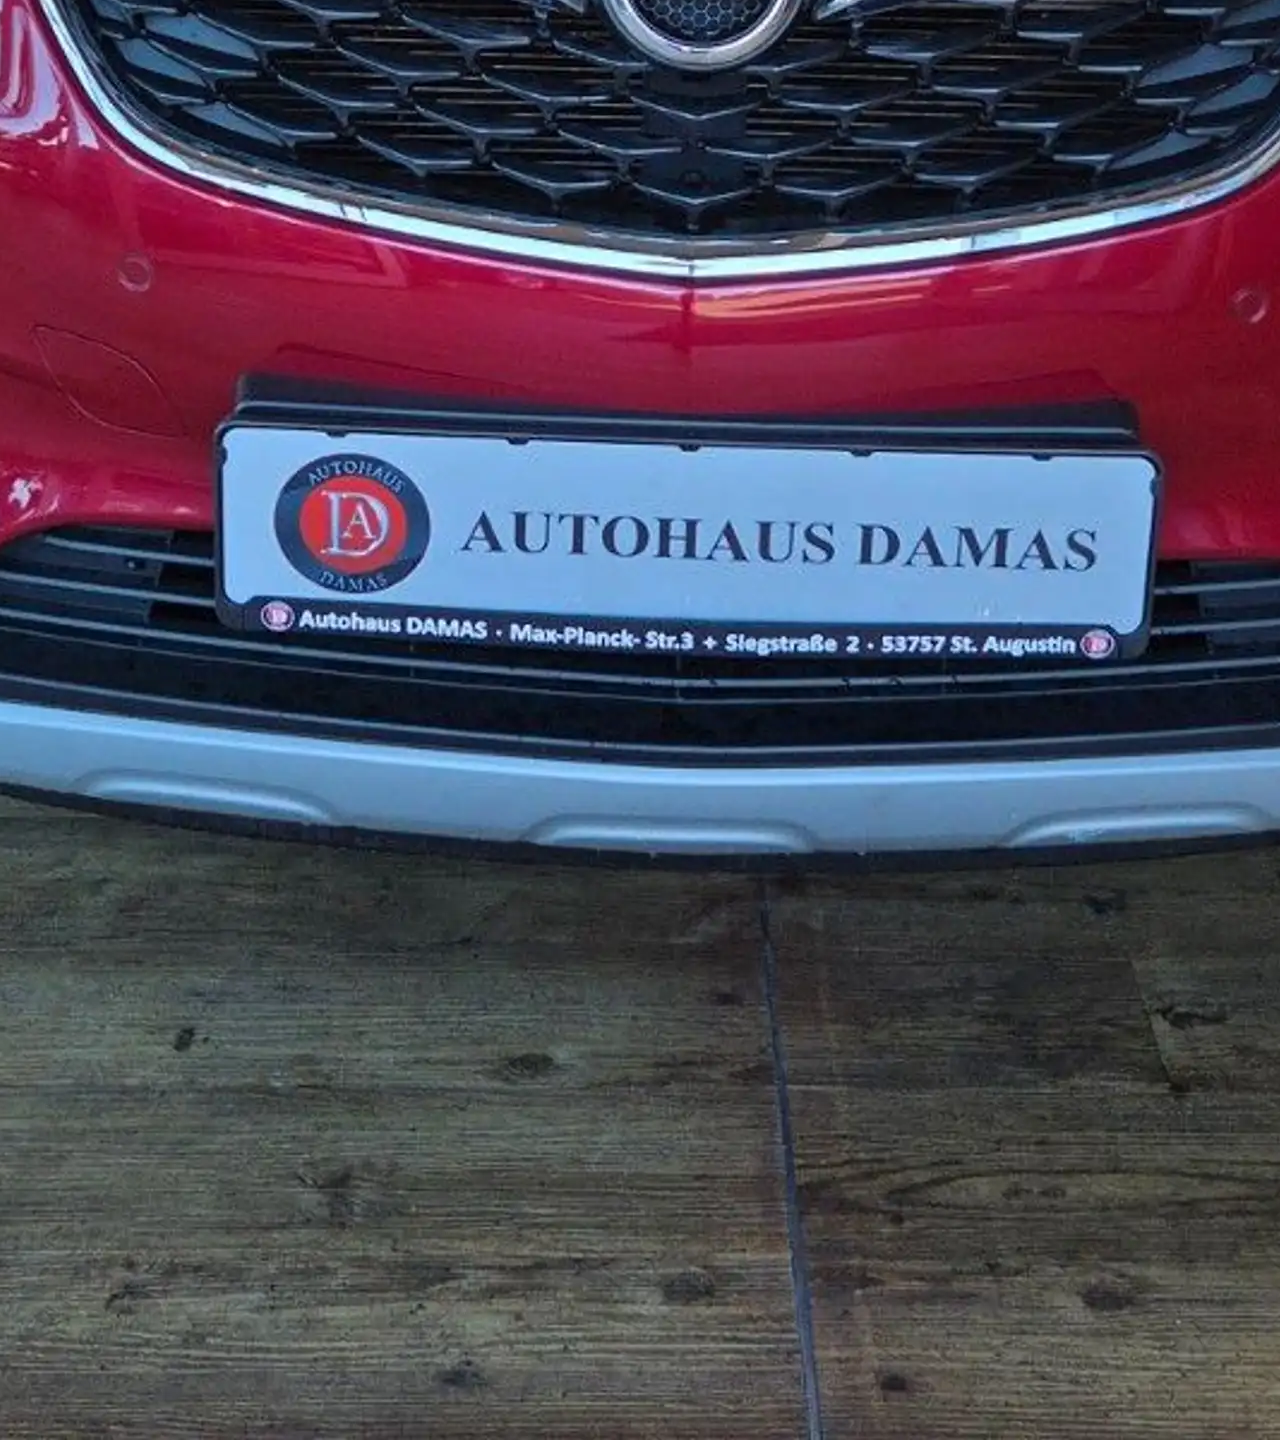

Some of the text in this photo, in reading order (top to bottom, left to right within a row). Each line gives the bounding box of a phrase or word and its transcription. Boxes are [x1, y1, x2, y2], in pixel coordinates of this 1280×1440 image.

[307, 460, 407, 494] AUTOHAUS
[460, 509, 1100, 573] AUTOHAUS DAMAS
[320, 570, 388, 592] DAMAS
[299, 609, 402, 635] Autohaus
[406, 616, 488, 640] DAMAS
[645, 627, 695, 650] Str.3
[846, 636, 860, 653] 2
[880, 635, 942, 653] 53757
[950, 635, 978, 653] St.
[983, 634, 1076, 657] Augustin
